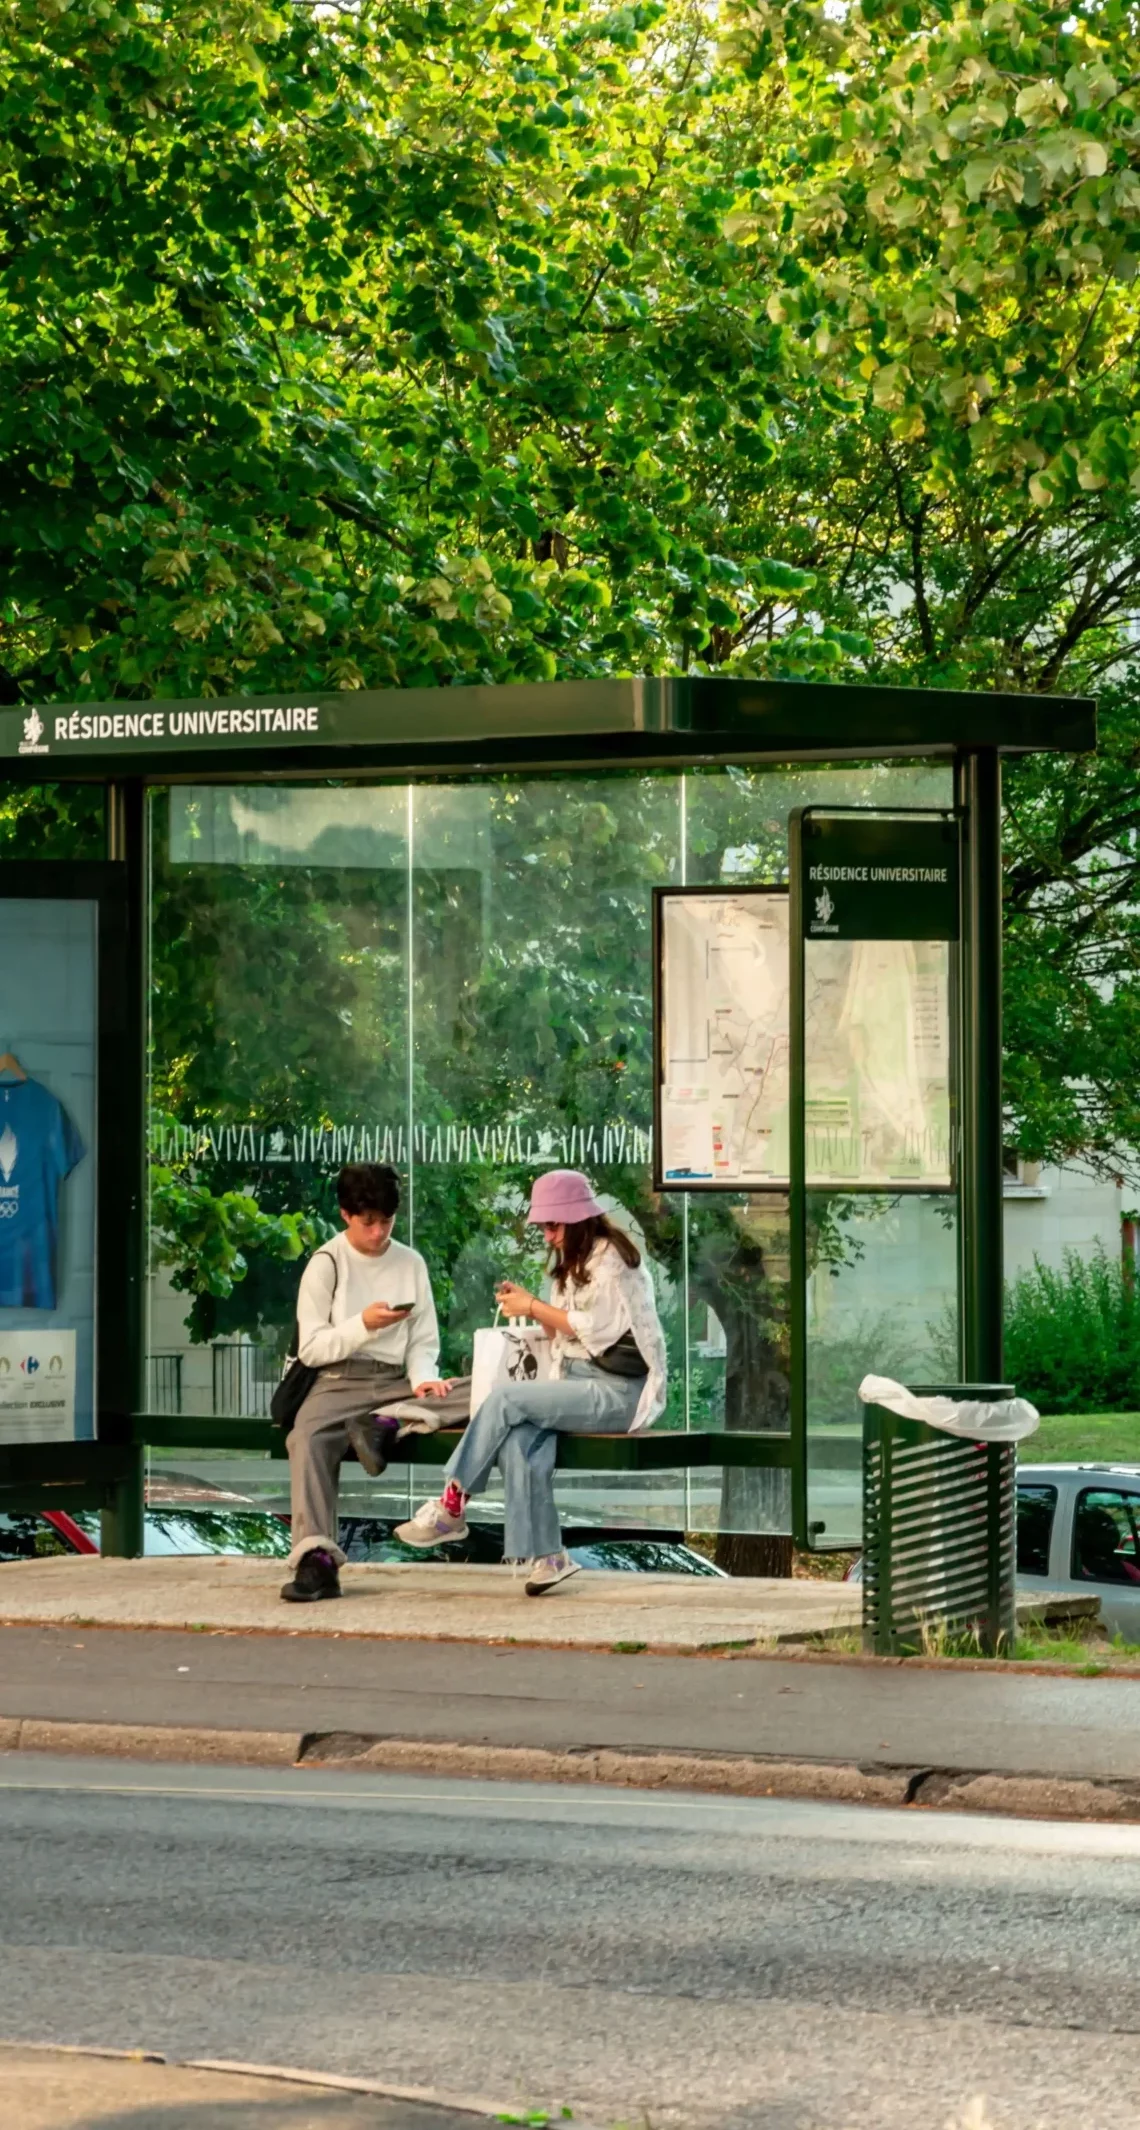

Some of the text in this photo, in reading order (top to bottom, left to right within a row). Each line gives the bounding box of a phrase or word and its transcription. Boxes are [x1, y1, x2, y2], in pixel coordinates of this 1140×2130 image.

[54, 706, 319, 740] RÉSIDENCE UNIVERSITAIRE
[809, 863, 948, 882] RÉSIDENCE UNIVERSITAIRE
